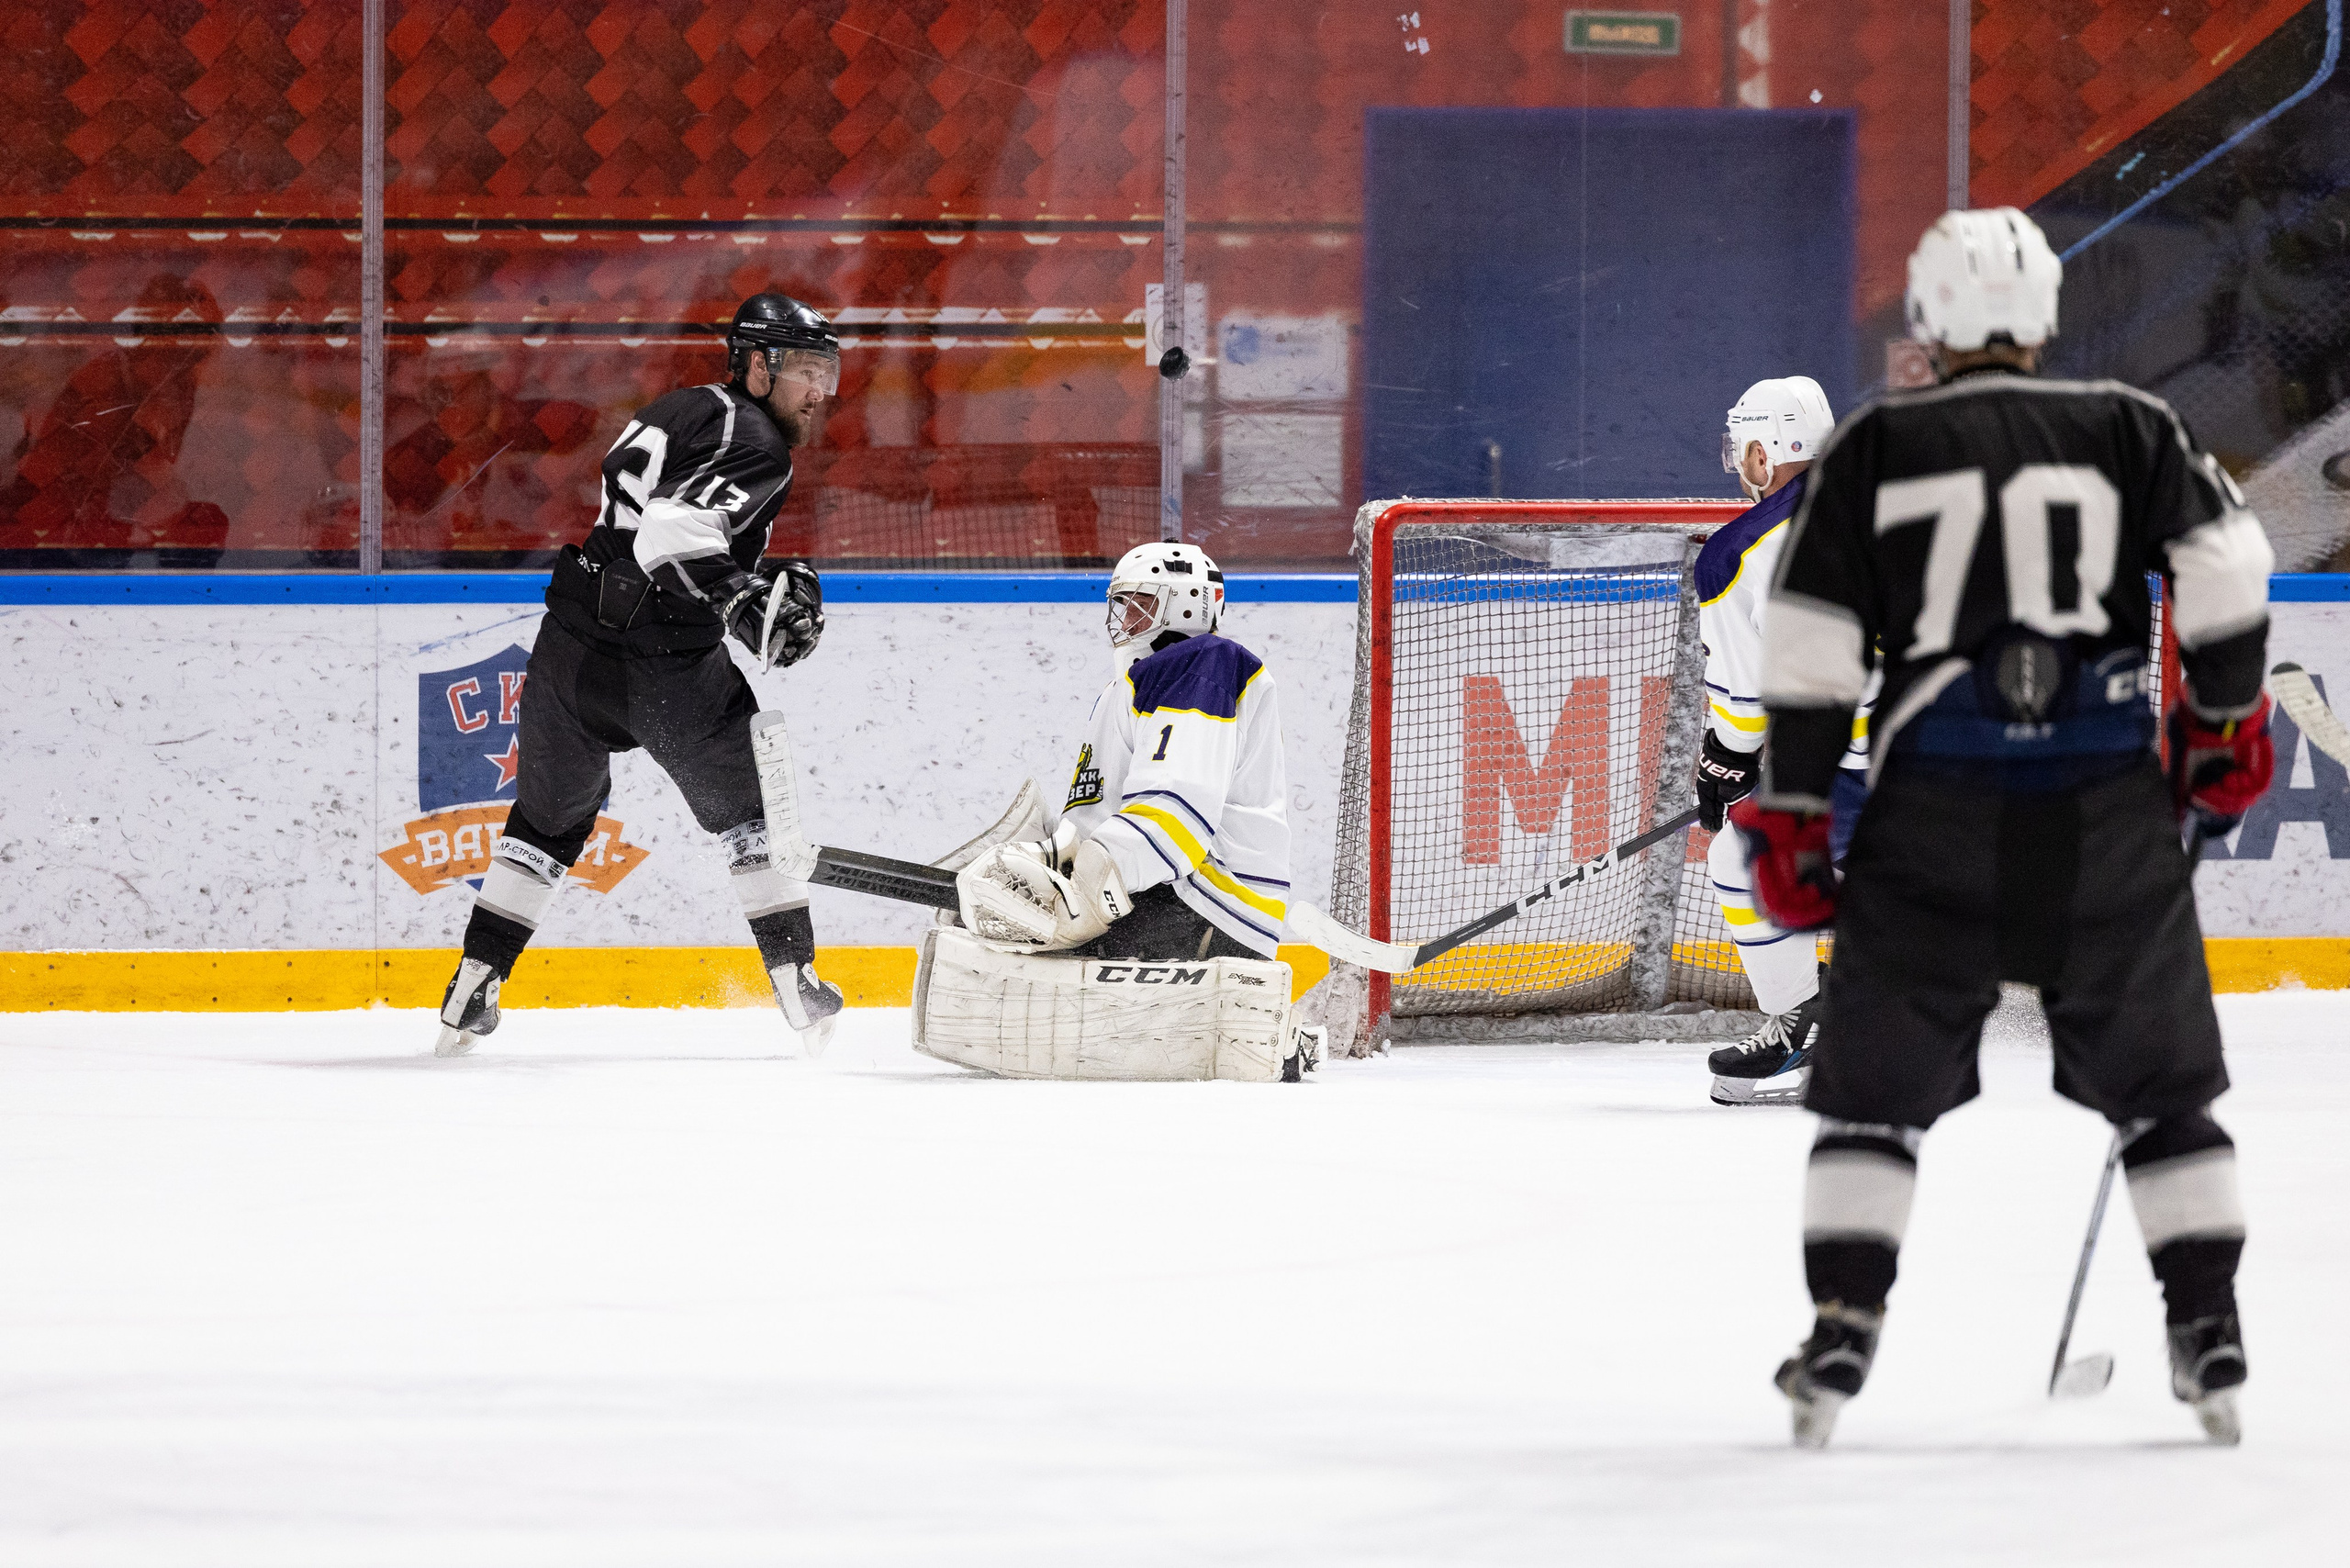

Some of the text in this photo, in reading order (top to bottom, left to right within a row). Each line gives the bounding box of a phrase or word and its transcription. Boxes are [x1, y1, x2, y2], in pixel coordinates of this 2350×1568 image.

[739, 321, 767, 330] BAUER
[694, 475, 751, 512] 13
[1874, 463, 2122, 661] 70
[446, 671, 530, 734] СК
[1152, 724, 1173, 761] 1
[1699, 753, 1745, 782] UER
[1516, 847, 1619, 913] CCM
[1095, 965, 1208, 986] CCM
